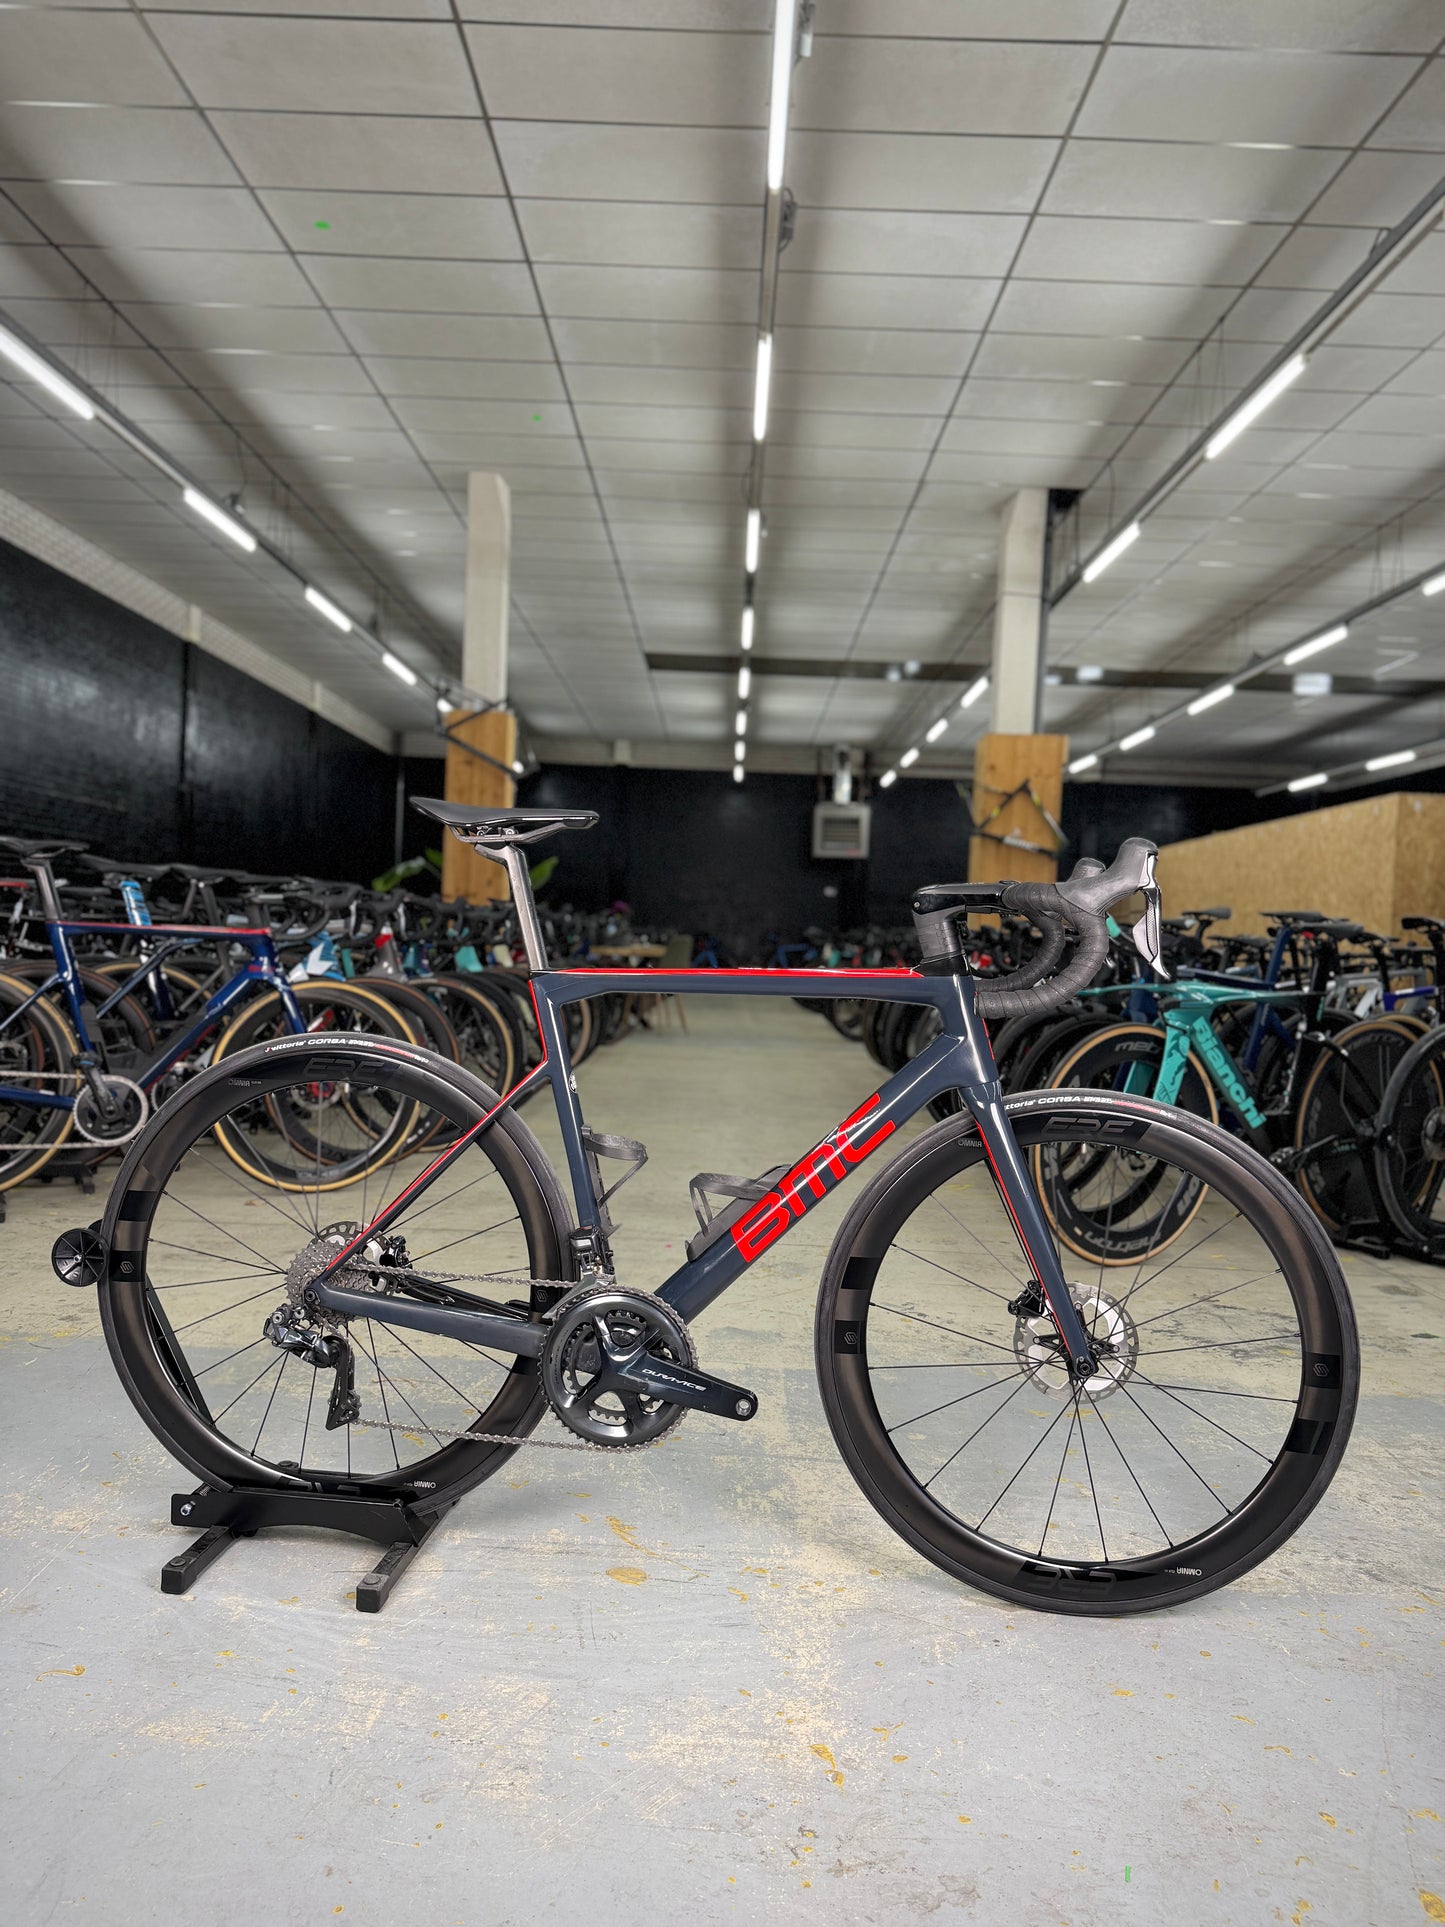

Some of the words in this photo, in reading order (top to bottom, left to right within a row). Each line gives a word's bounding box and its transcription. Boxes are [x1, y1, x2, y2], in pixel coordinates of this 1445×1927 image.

[270, 1041, 306, 1051] vittoria
[1192, 1016, 1267, 1129] Bianchi
[1005, 1099, 1035, 1110] ttoria
[641, 1368, 707, 1392] DURA-ACE
[1176, 1566, 1202, 1577] OMNIA
